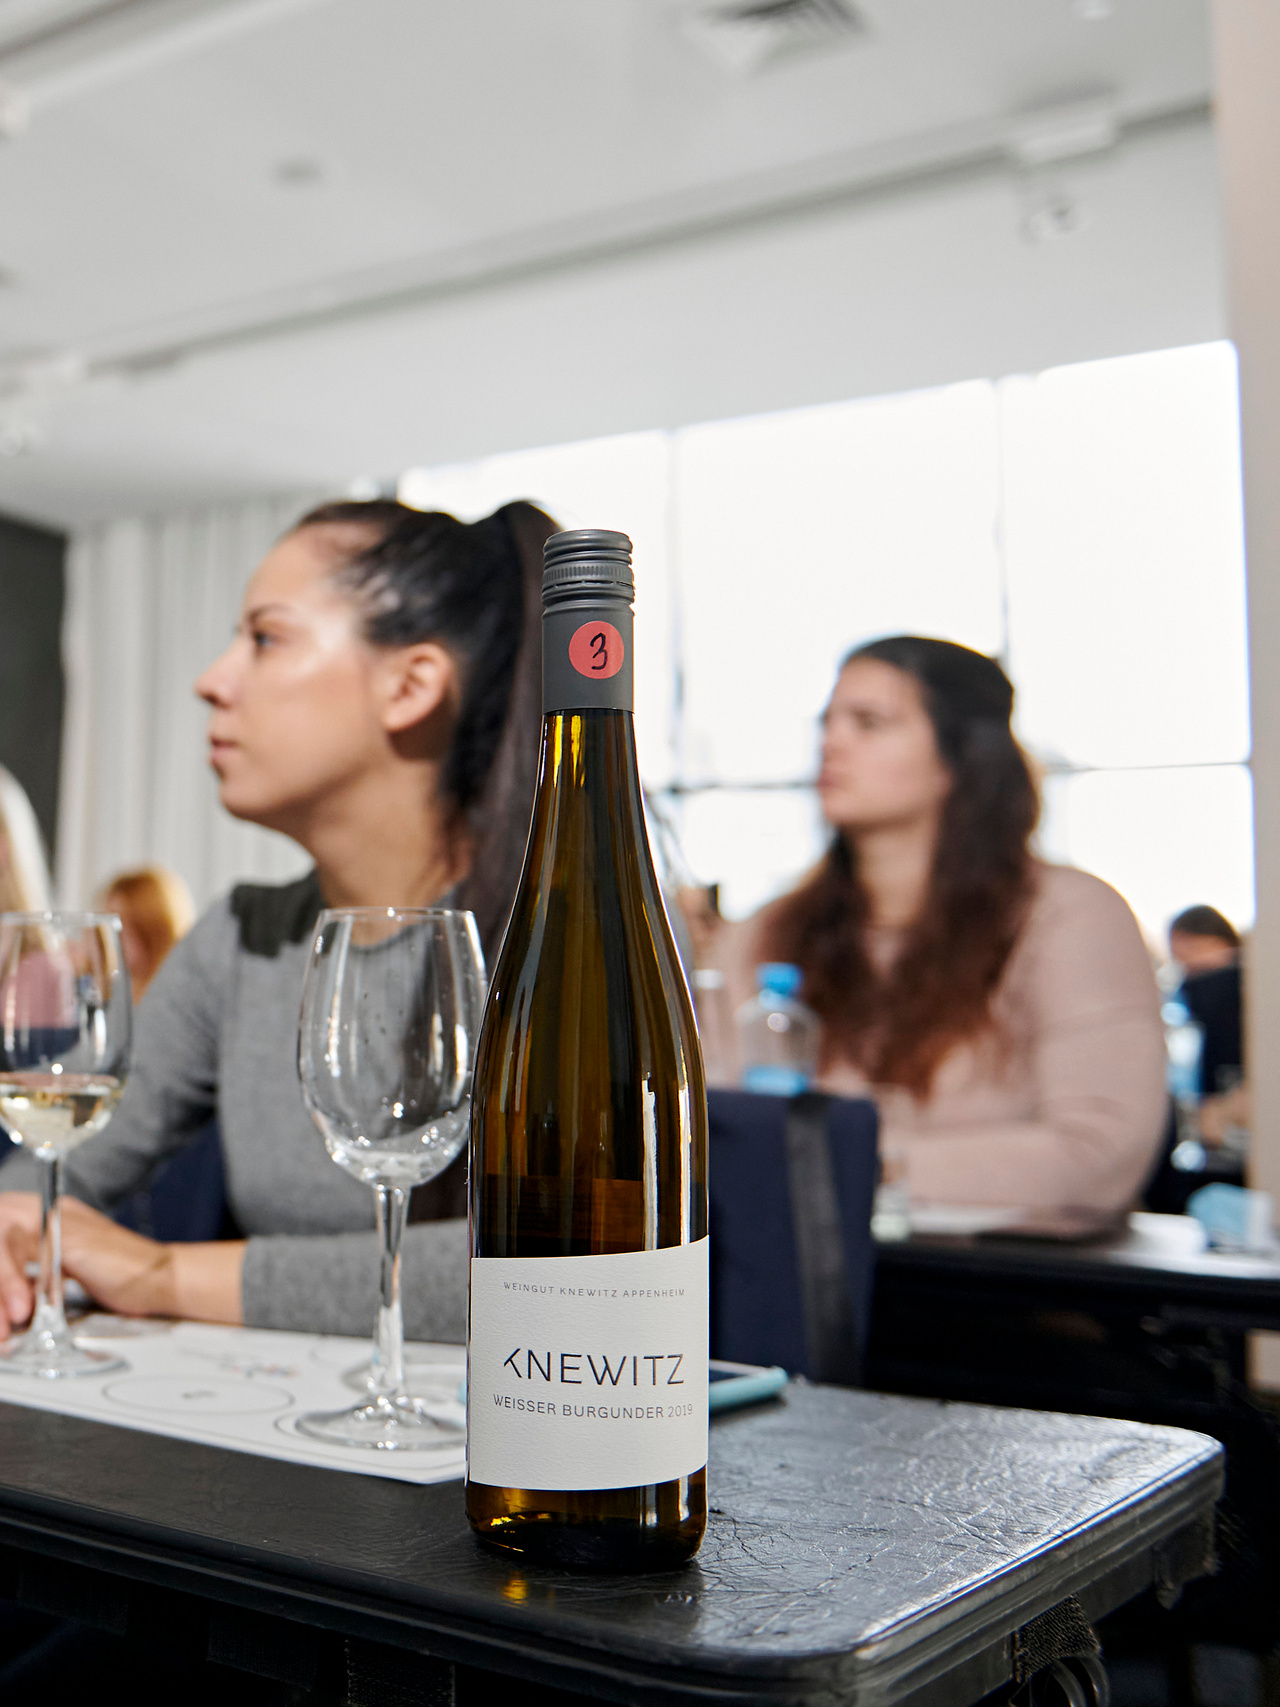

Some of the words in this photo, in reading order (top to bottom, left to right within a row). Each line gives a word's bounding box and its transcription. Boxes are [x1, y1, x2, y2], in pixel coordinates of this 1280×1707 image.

[589, 632, 608, 670] 3
[503, 1281, 555, 1294] WEINGUT
[559, 1287, 618, 1298] KNEWITZ
[623, 1288, 686, 1298] APPENHEIM
[503, 1348, 684, 1386] KNEWITZ
[493, 1394, 557, 1415] WEISSER
[562, 1404, 665, 1419] BURGUNDER
[667, 1403, 694, 1418] 2019
